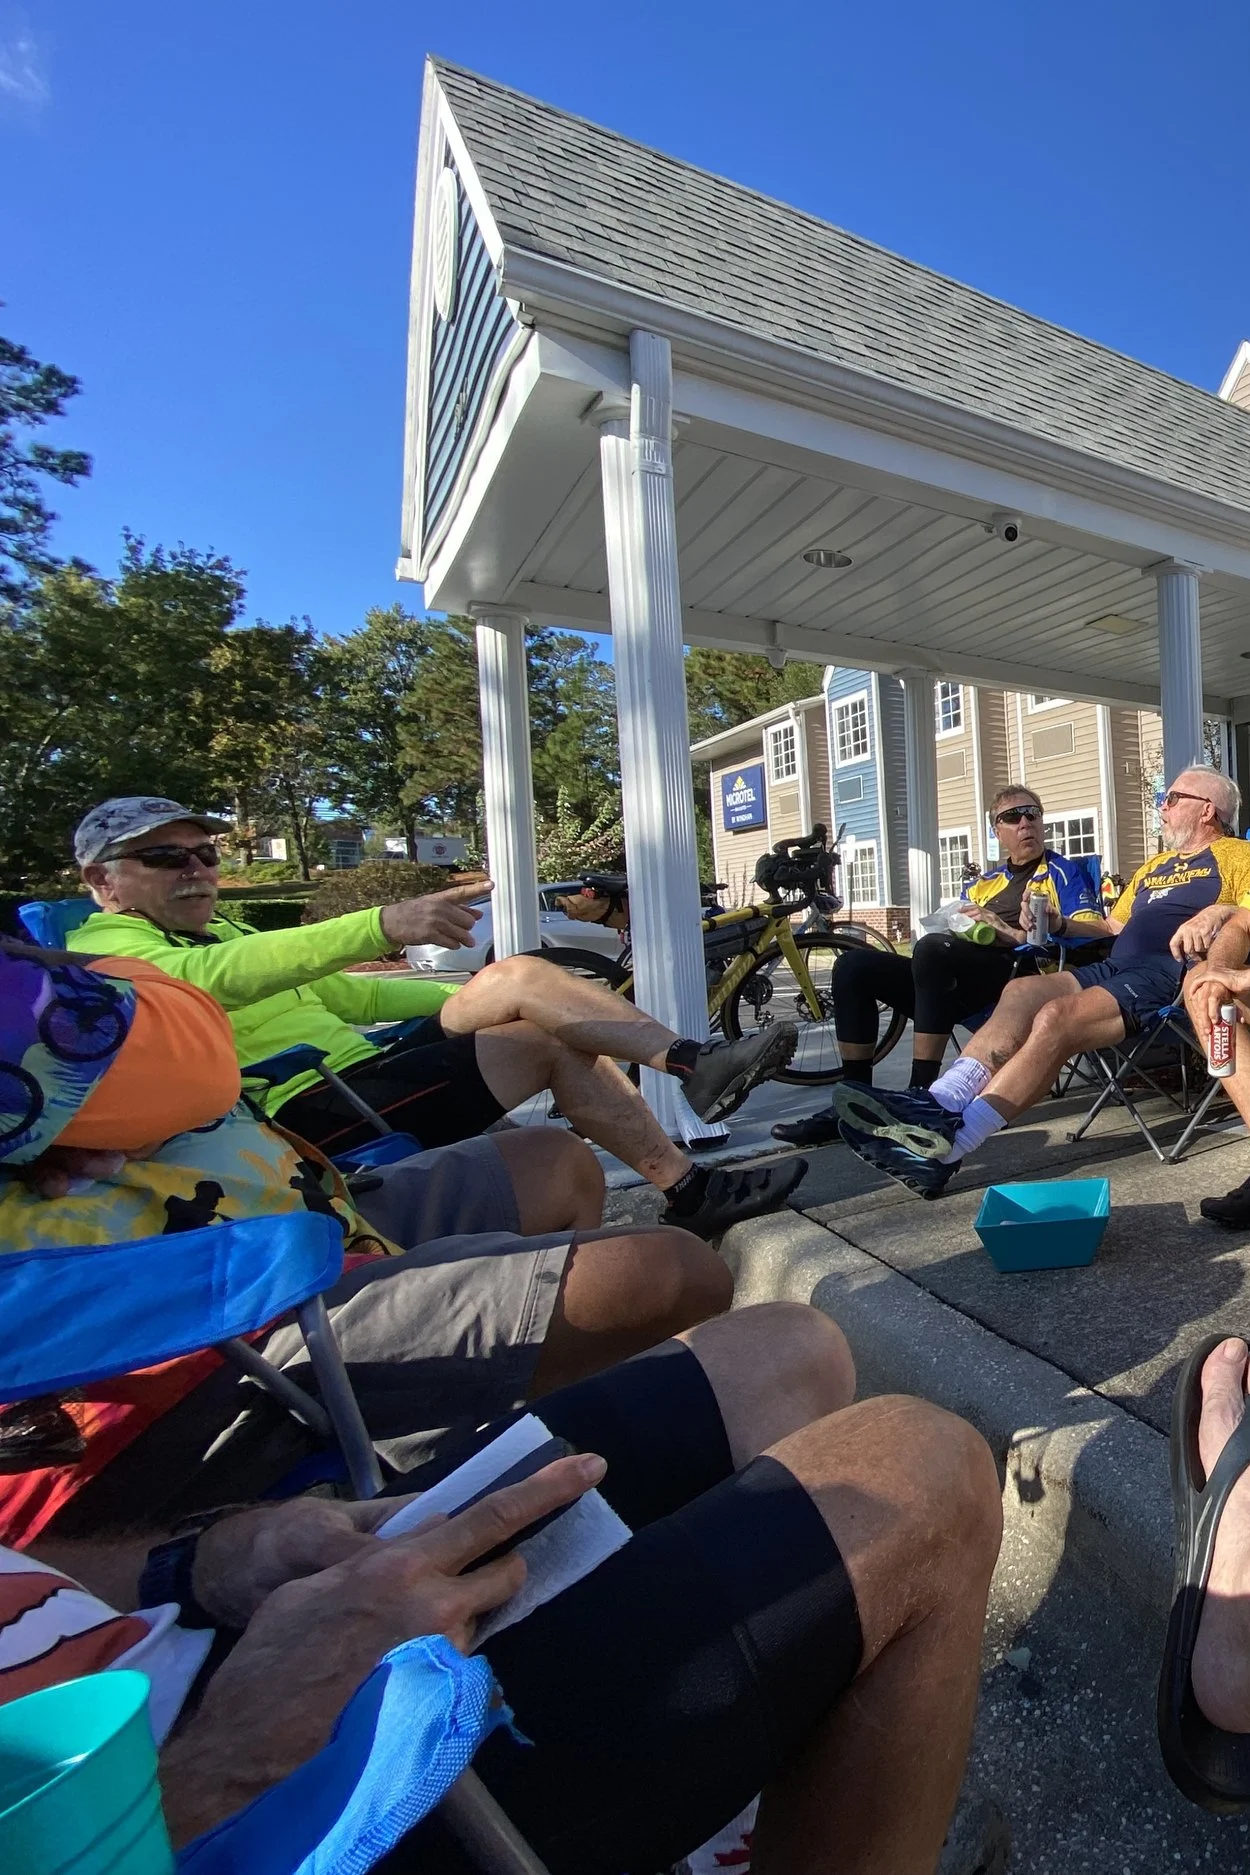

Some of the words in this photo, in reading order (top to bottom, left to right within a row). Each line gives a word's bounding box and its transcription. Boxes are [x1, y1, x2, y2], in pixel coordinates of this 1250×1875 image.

[726, 788, 756, 807] MICROTEL
[1213, 1025, 1221, 1060] ARTOIS
[1221, 1026, 1229, 1060] STELLA
